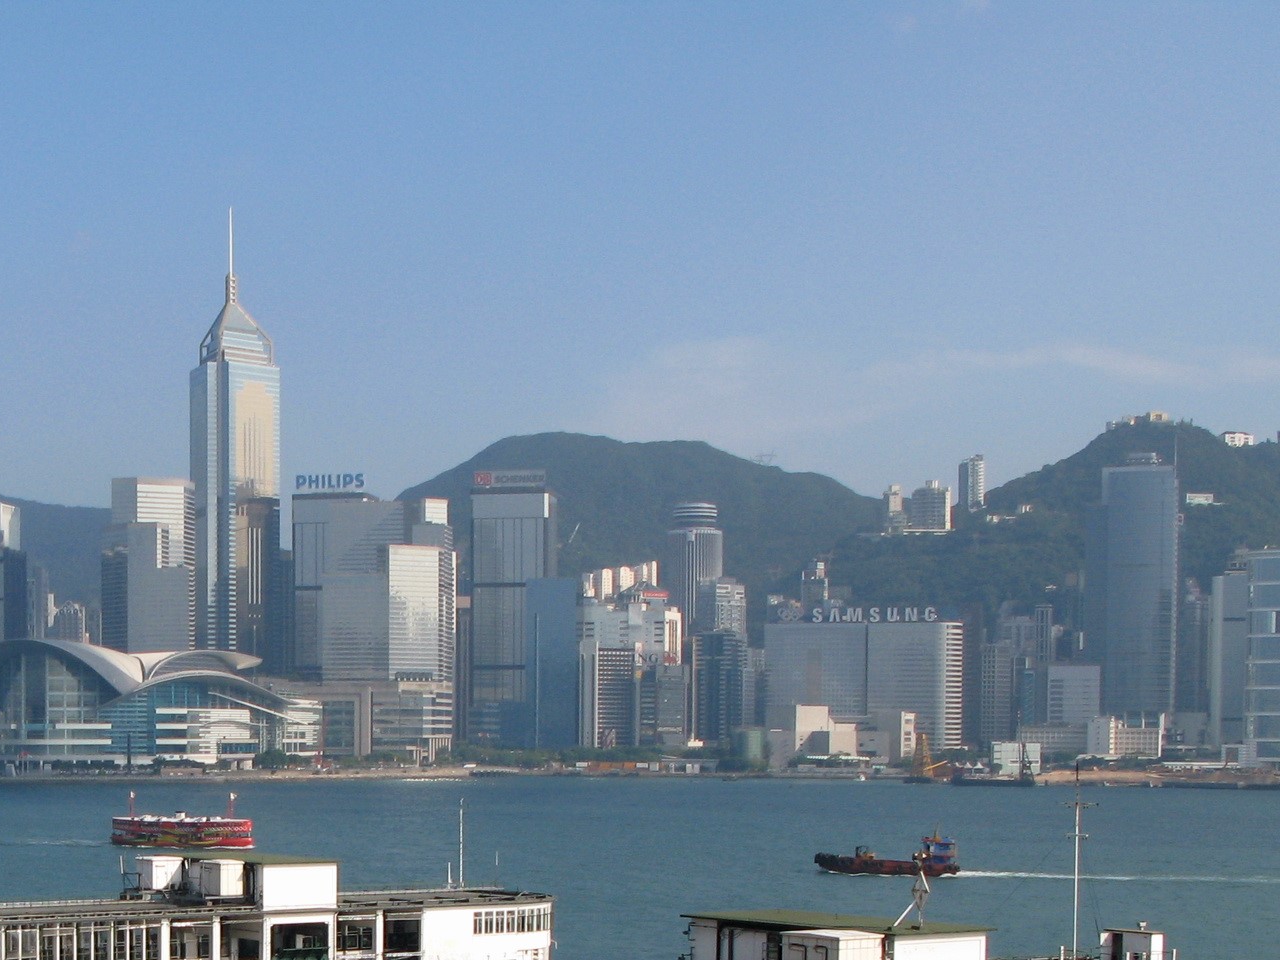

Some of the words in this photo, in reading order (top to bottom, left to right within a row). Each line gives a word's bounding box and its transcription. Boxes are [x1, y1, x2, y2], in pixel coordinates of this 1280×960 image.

[295, 473, 366, 490] PHILIPS
[494, 474, 545, 484] SCHENKER
[812, 606, 938, 623] SAMSUNG
